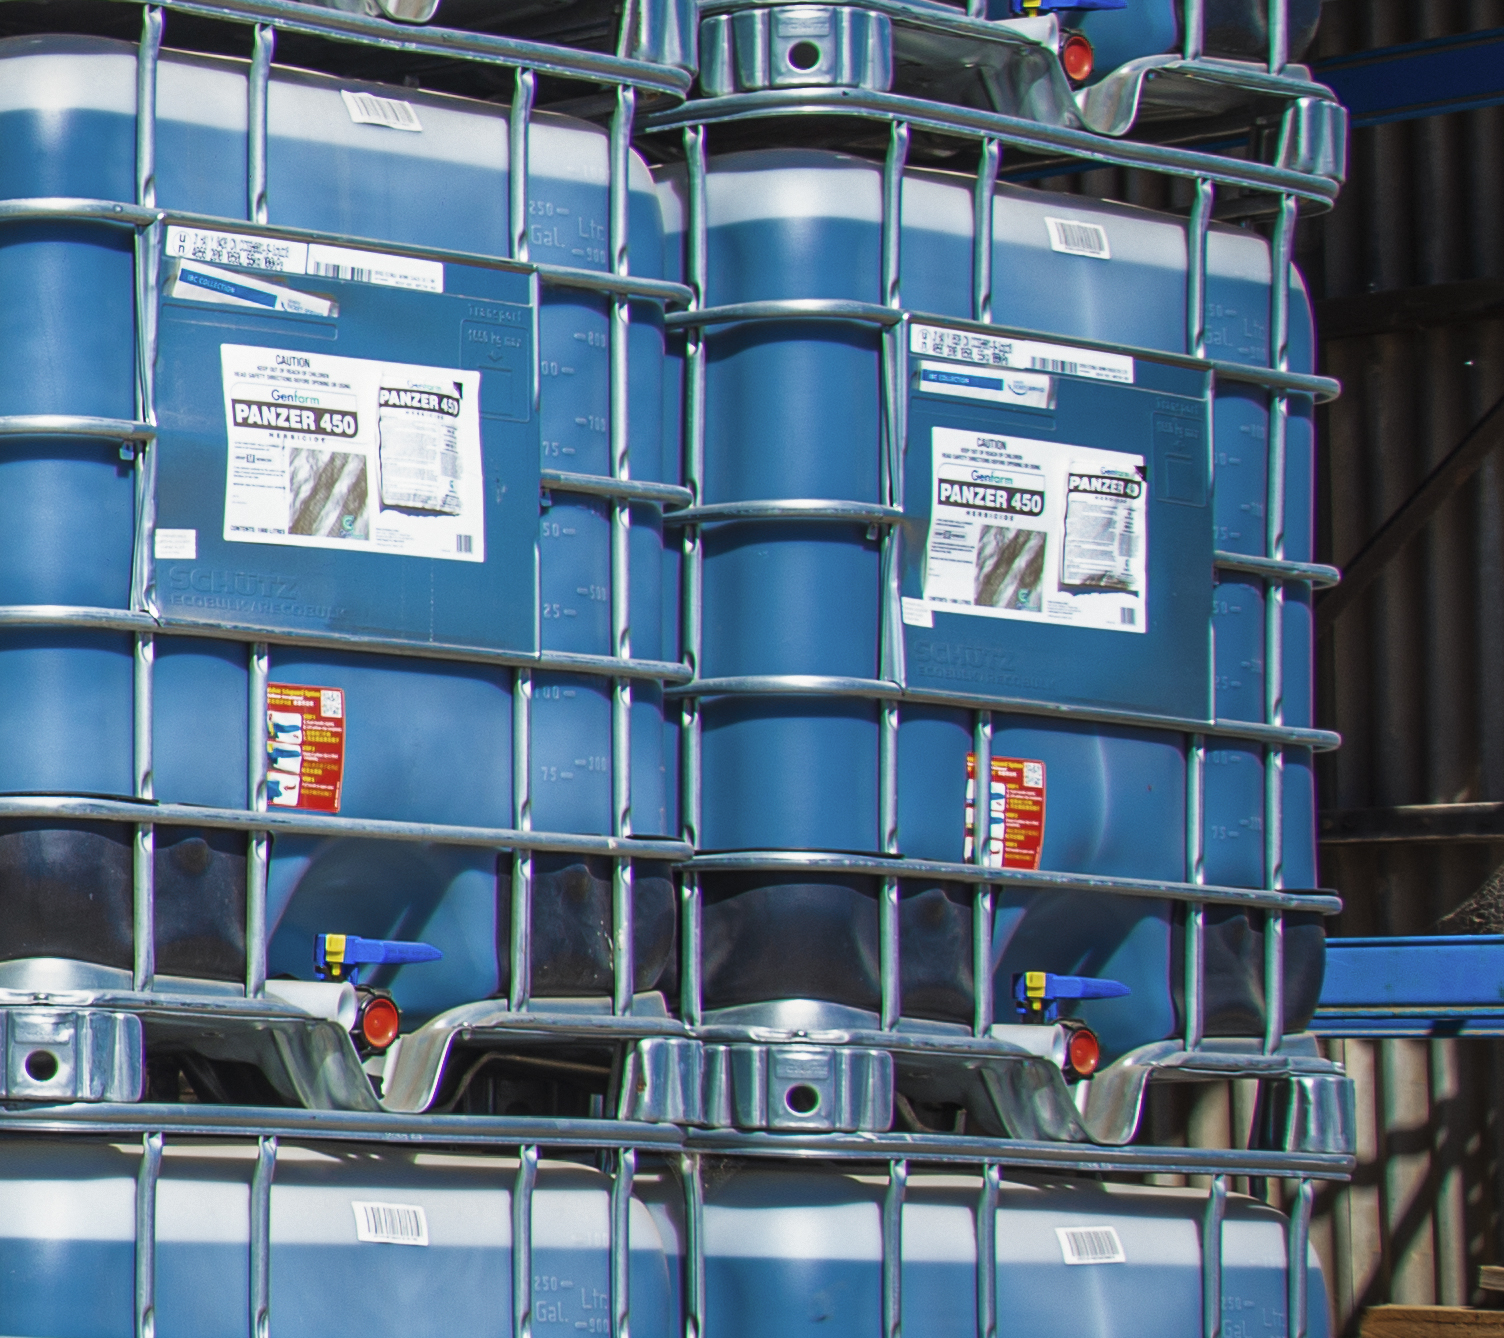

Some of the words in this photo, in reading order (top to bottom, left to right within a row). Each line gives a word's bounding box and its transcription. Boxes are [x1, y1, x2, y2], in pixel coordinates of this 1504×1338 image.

[275, 354, 310, 368] CAUTION
[271, 389, 319, 405] Genfarm
[380, 389, 439, 410] PANZER
[234, 403, 316, 431] PANZER
[319, 414, 355, 435] 450
[971, 469, 1013, 485] Genfarm
[939, 483, 1007, 509] PANZER
[1010, 493, 1043, 513] 450
